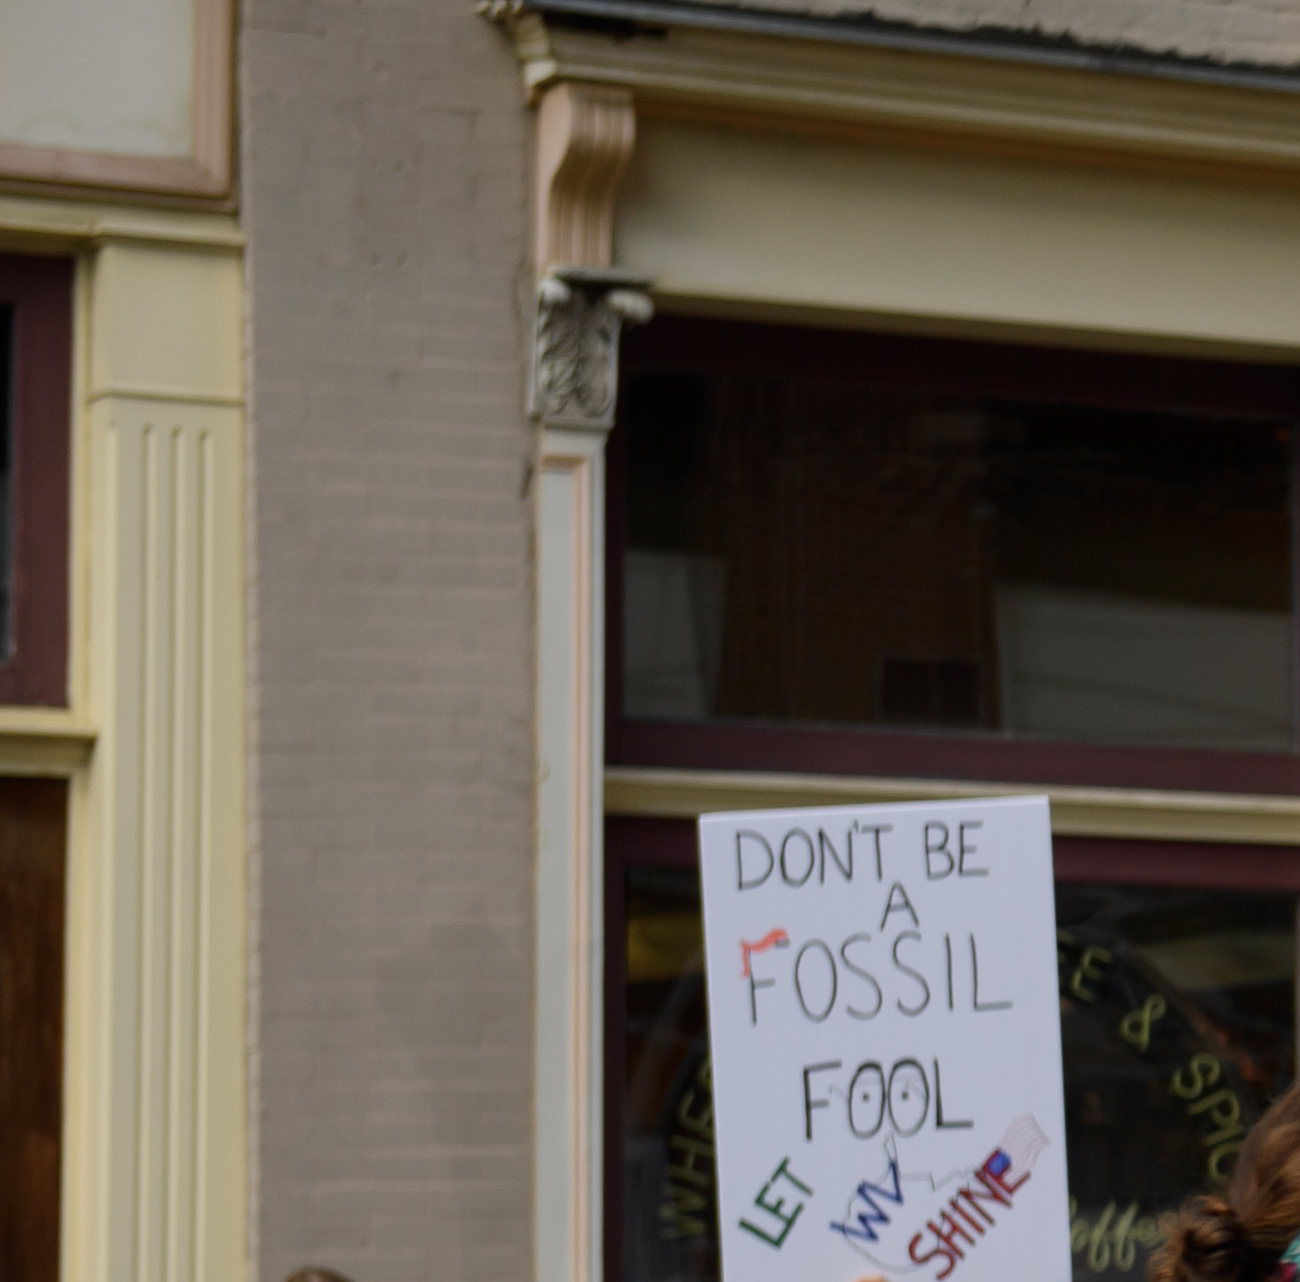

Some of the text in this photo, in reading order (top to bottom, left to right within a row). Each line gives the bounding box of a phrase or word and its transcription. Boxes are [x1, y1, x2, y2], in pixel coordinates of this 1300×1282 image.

[735, 820, 992, 891] DON'T BE
[880, 882, 921, 931] A
[739, 927, 1014, 1027] FOSSIL
[800, 1057, 975, 1141] FOOL
[1171, 1050, 1245, 1182] SPIC
[738, 1147, 1032, 1282] LET WV SHINE
